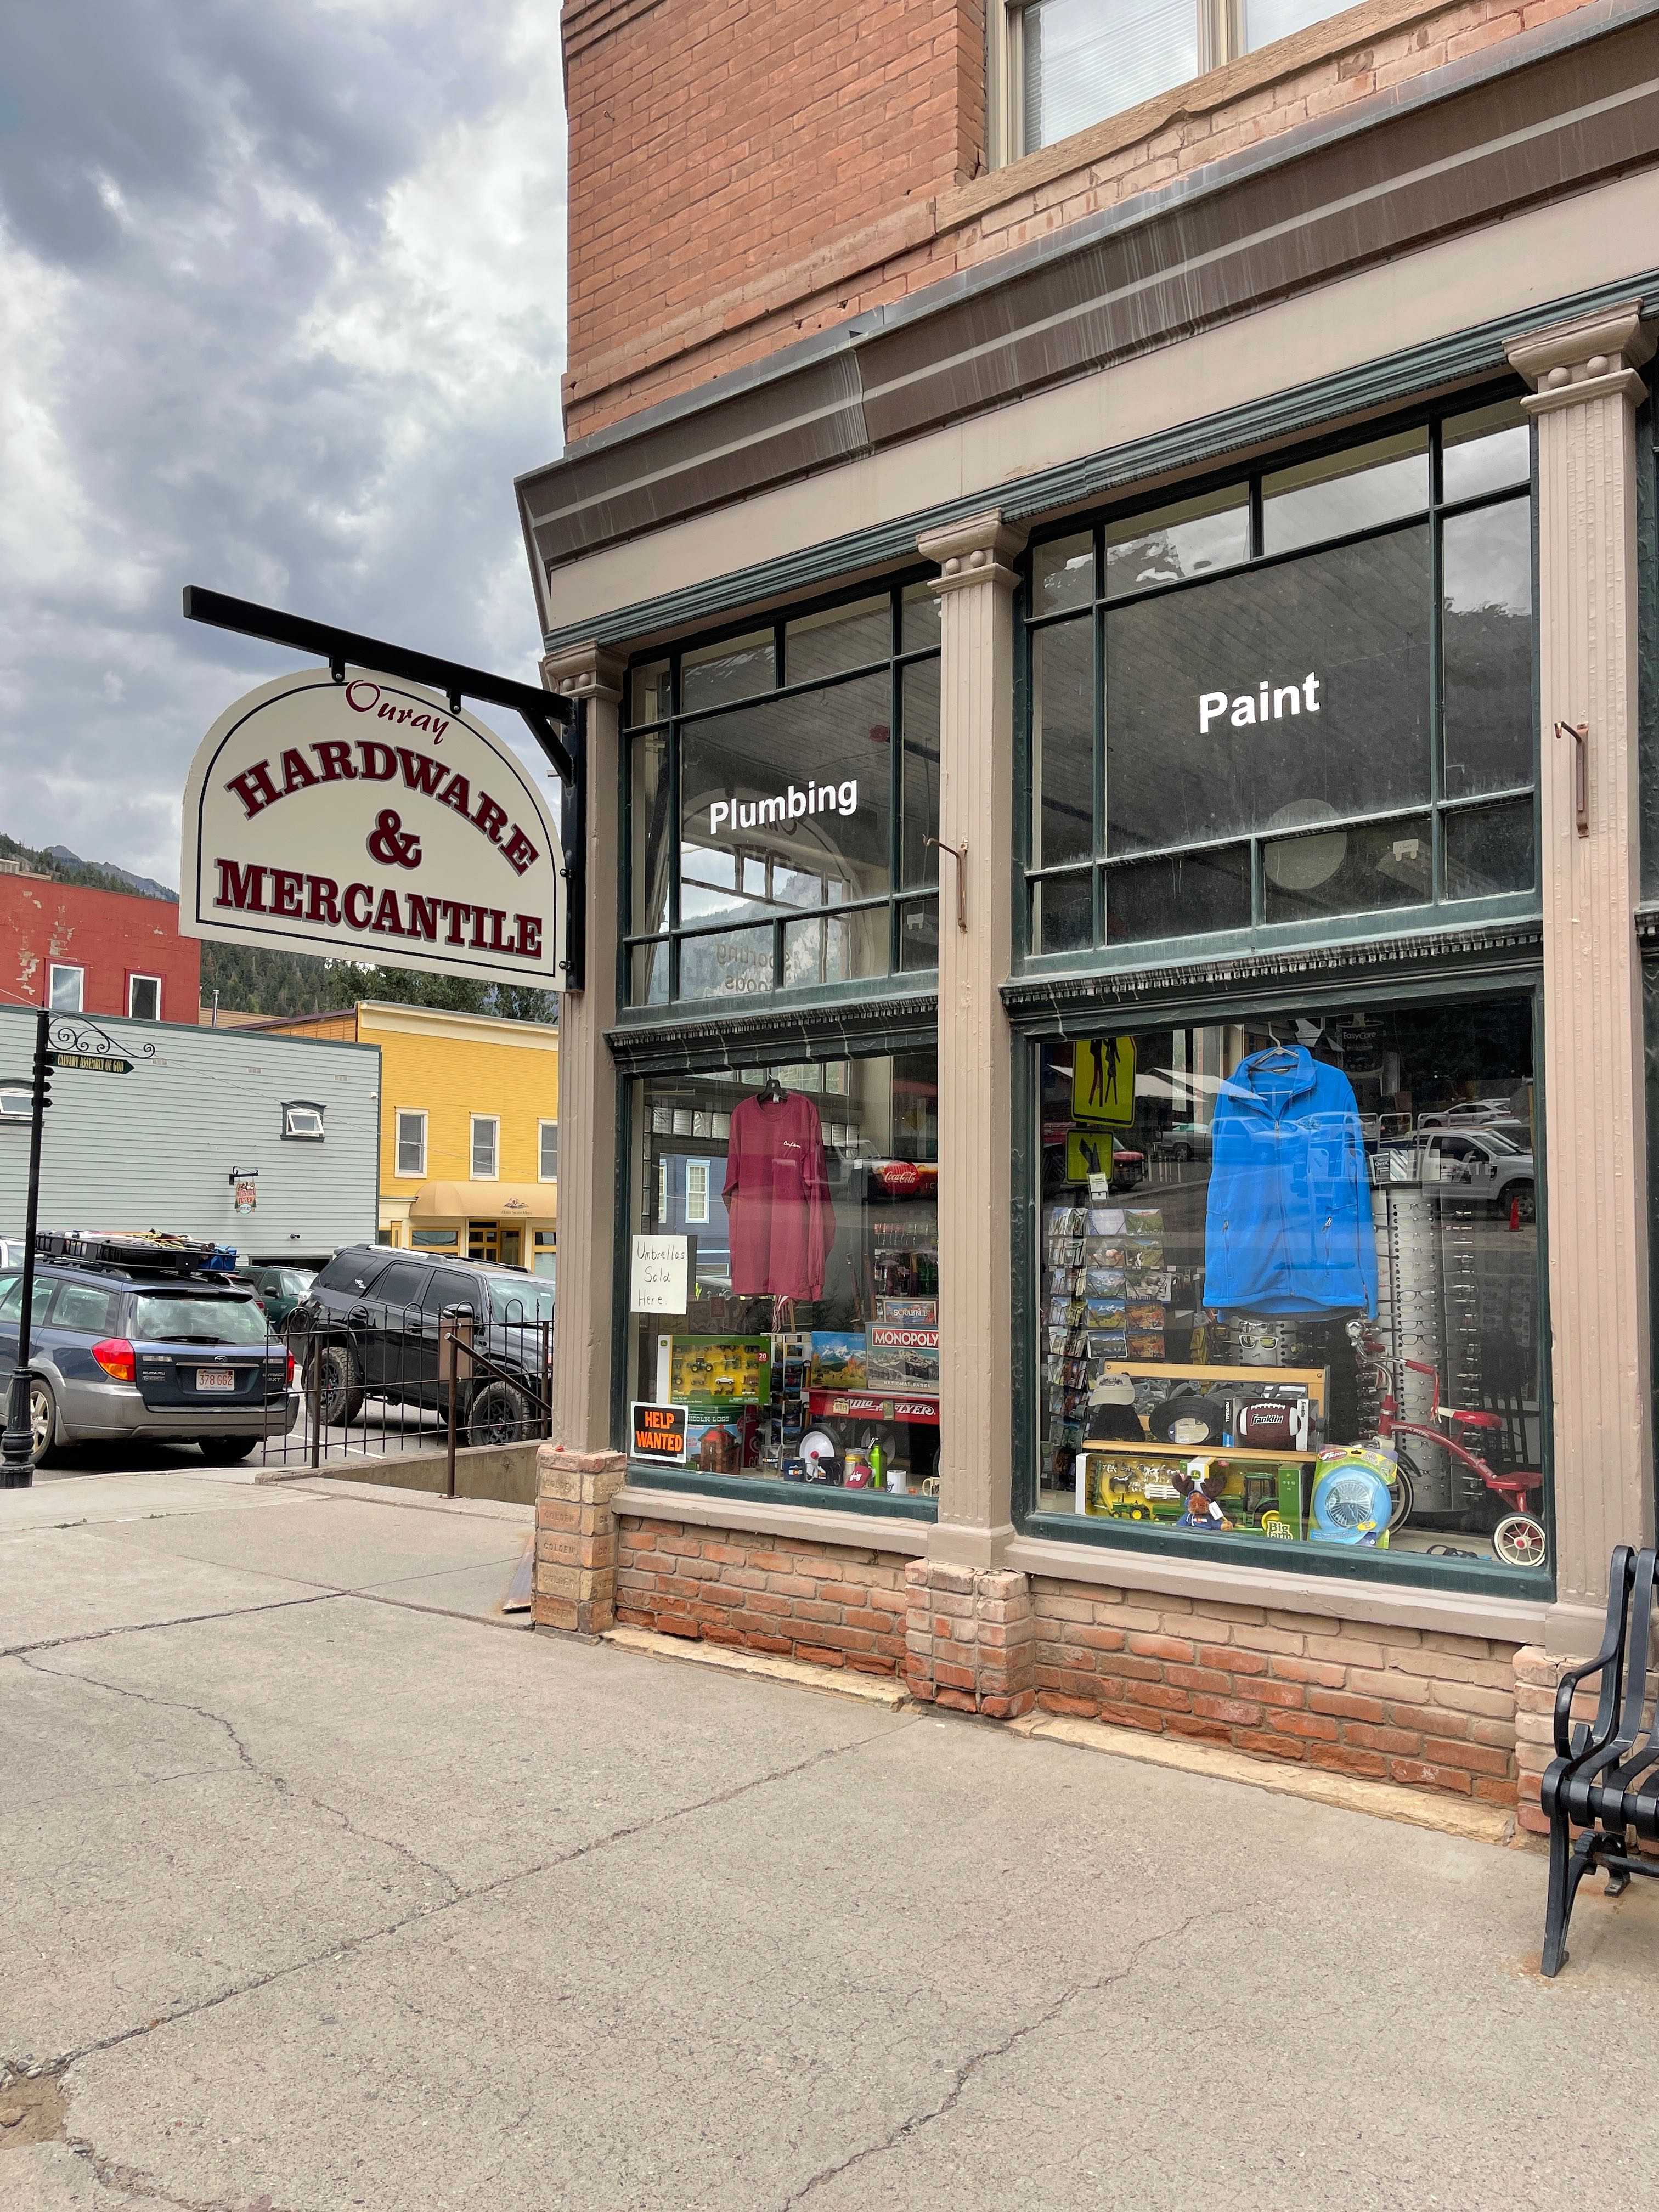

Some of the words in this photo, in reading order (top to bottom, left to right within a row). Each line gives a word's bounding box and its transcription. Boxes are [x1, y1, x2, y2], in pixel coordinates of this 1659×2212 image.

[345, 679, 450, 744] Ouray
[1199, 672, 1321, 734] Paint
[224, 740, 540, 877] HARDWARE
[710, 780, 857, 834] Plumbing
[366, 809, 421, 869] &
[213, 857, 543, 959] MERCANTILE
[1343, 1032, 1376, 1040] EasyCare
[57, 1054, 79, 1068] CALVARY
[80, 1057, 104, 1070] ASSEMBLY
[105, 1059, 112, 1071] OF
[112, 1060, 124, 1073] GOD
[637, 1240, 685, 1260] Umbrellas
[644, 1266, 670, 1282] Sold
[893, 1308, 928, 1317] SCRABBLE
[874, 1331, 939, 1347] MONOPOLY
[200, 1375, 215, 1385] 378
[217, 1375, 232, 1386] GG2
[645, 1410, 675, 1429] HELP
[636, 1431, 682, 1452] WANTED
[1269, 1522, 1288, 1532] Big
